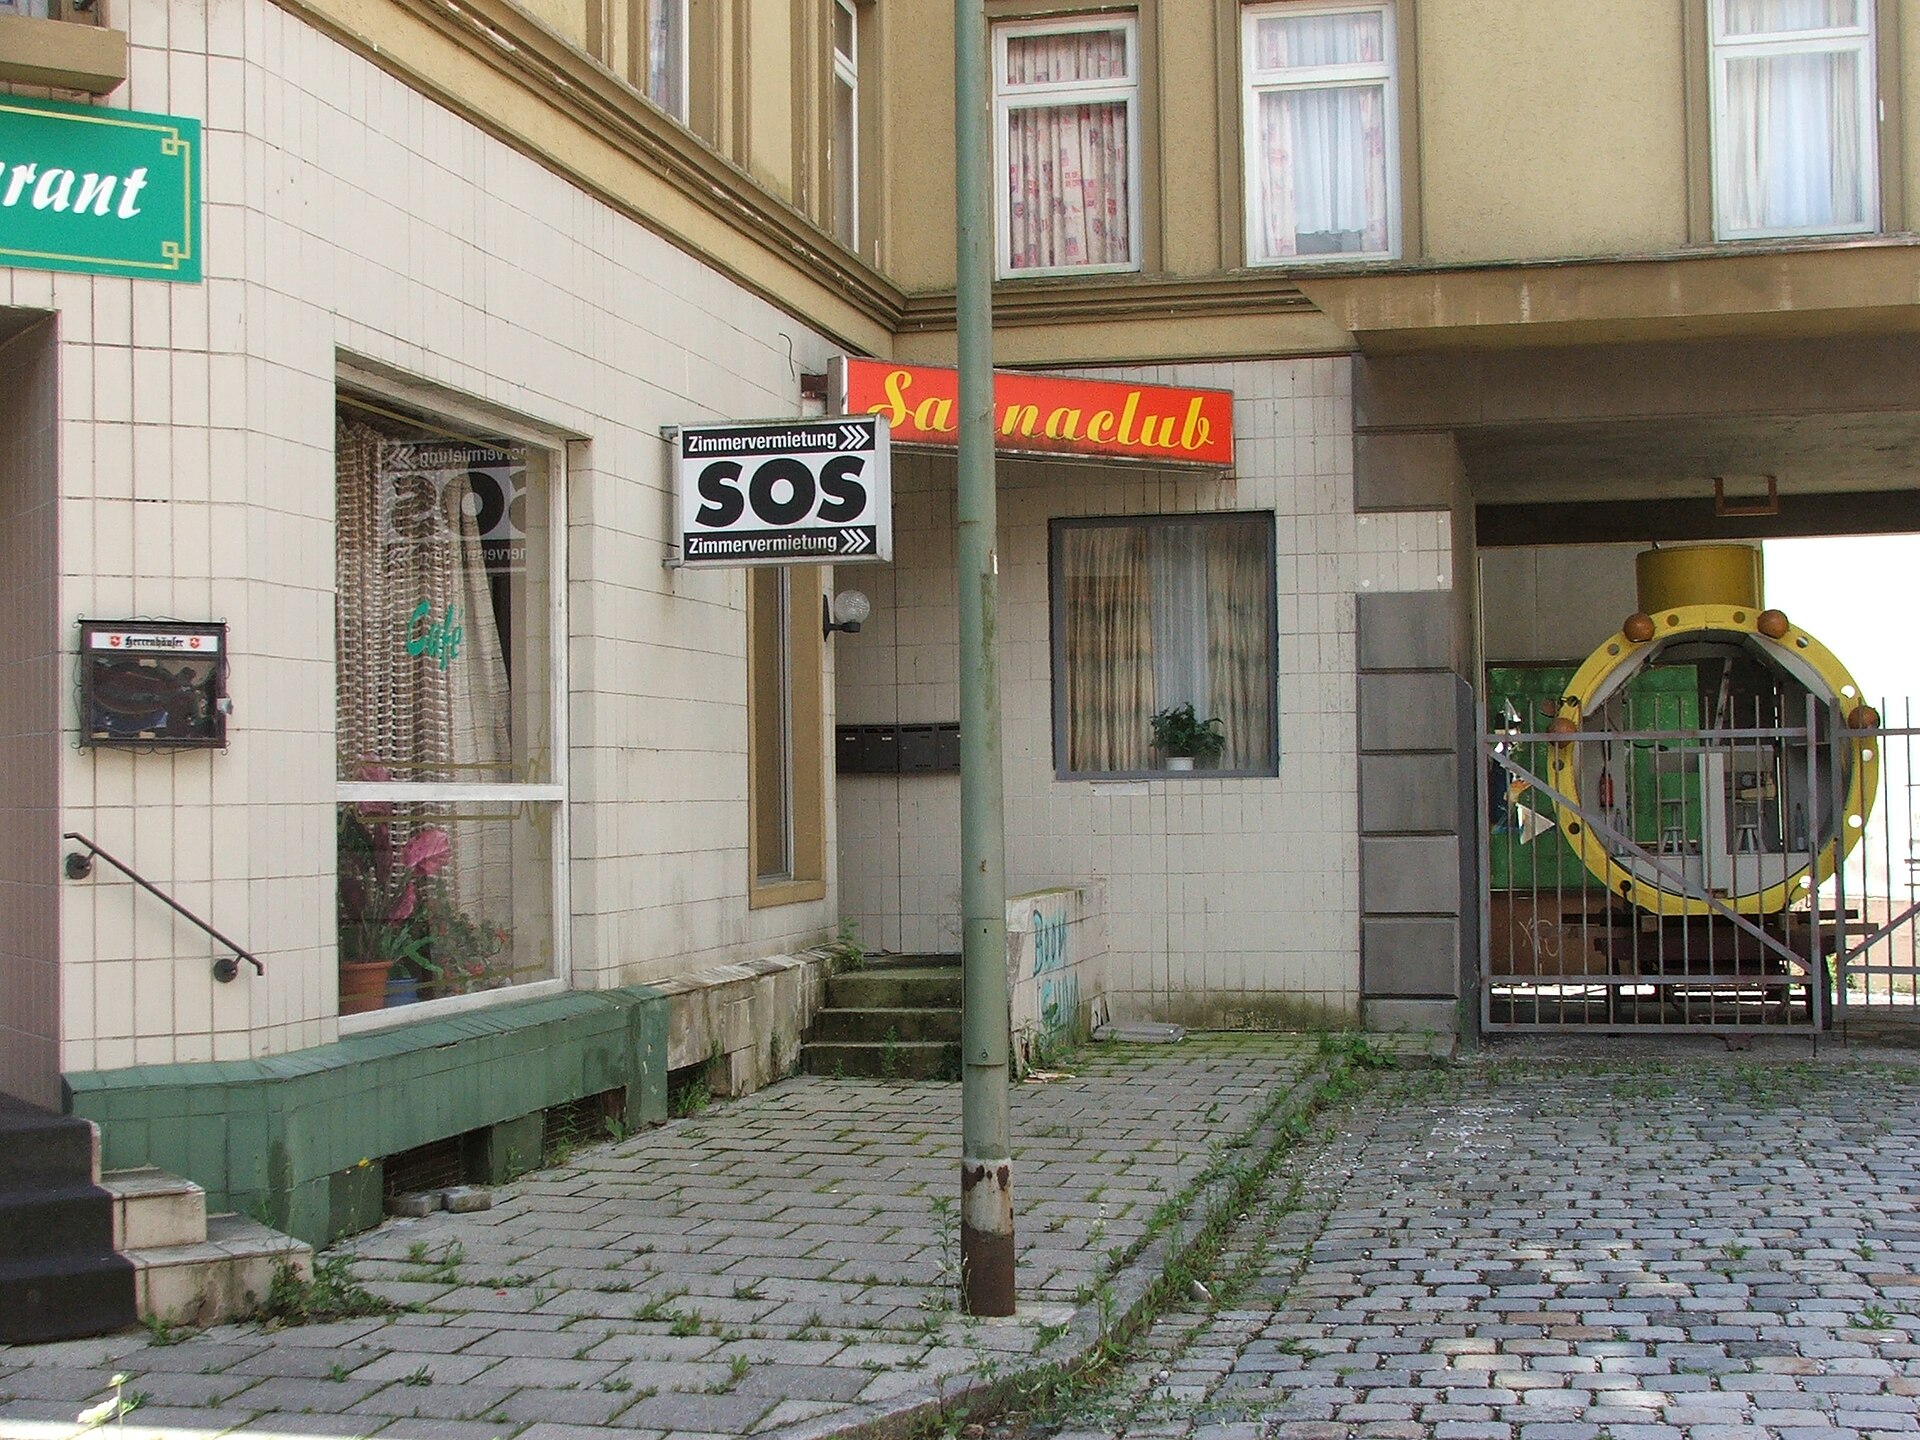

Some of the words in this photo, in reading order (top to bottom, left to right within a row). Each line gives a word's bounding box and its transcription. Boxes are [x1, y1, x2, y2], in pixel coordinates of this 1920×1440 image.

[0, 161, 148, 219] rant
[867, 370, 1214, 450] Sanaclub
[688, 431, 837, 452] Zimmervermietung
[695, 455, 867, 528] SOS
[688, 535, 838, 554] Zimmervermietung
